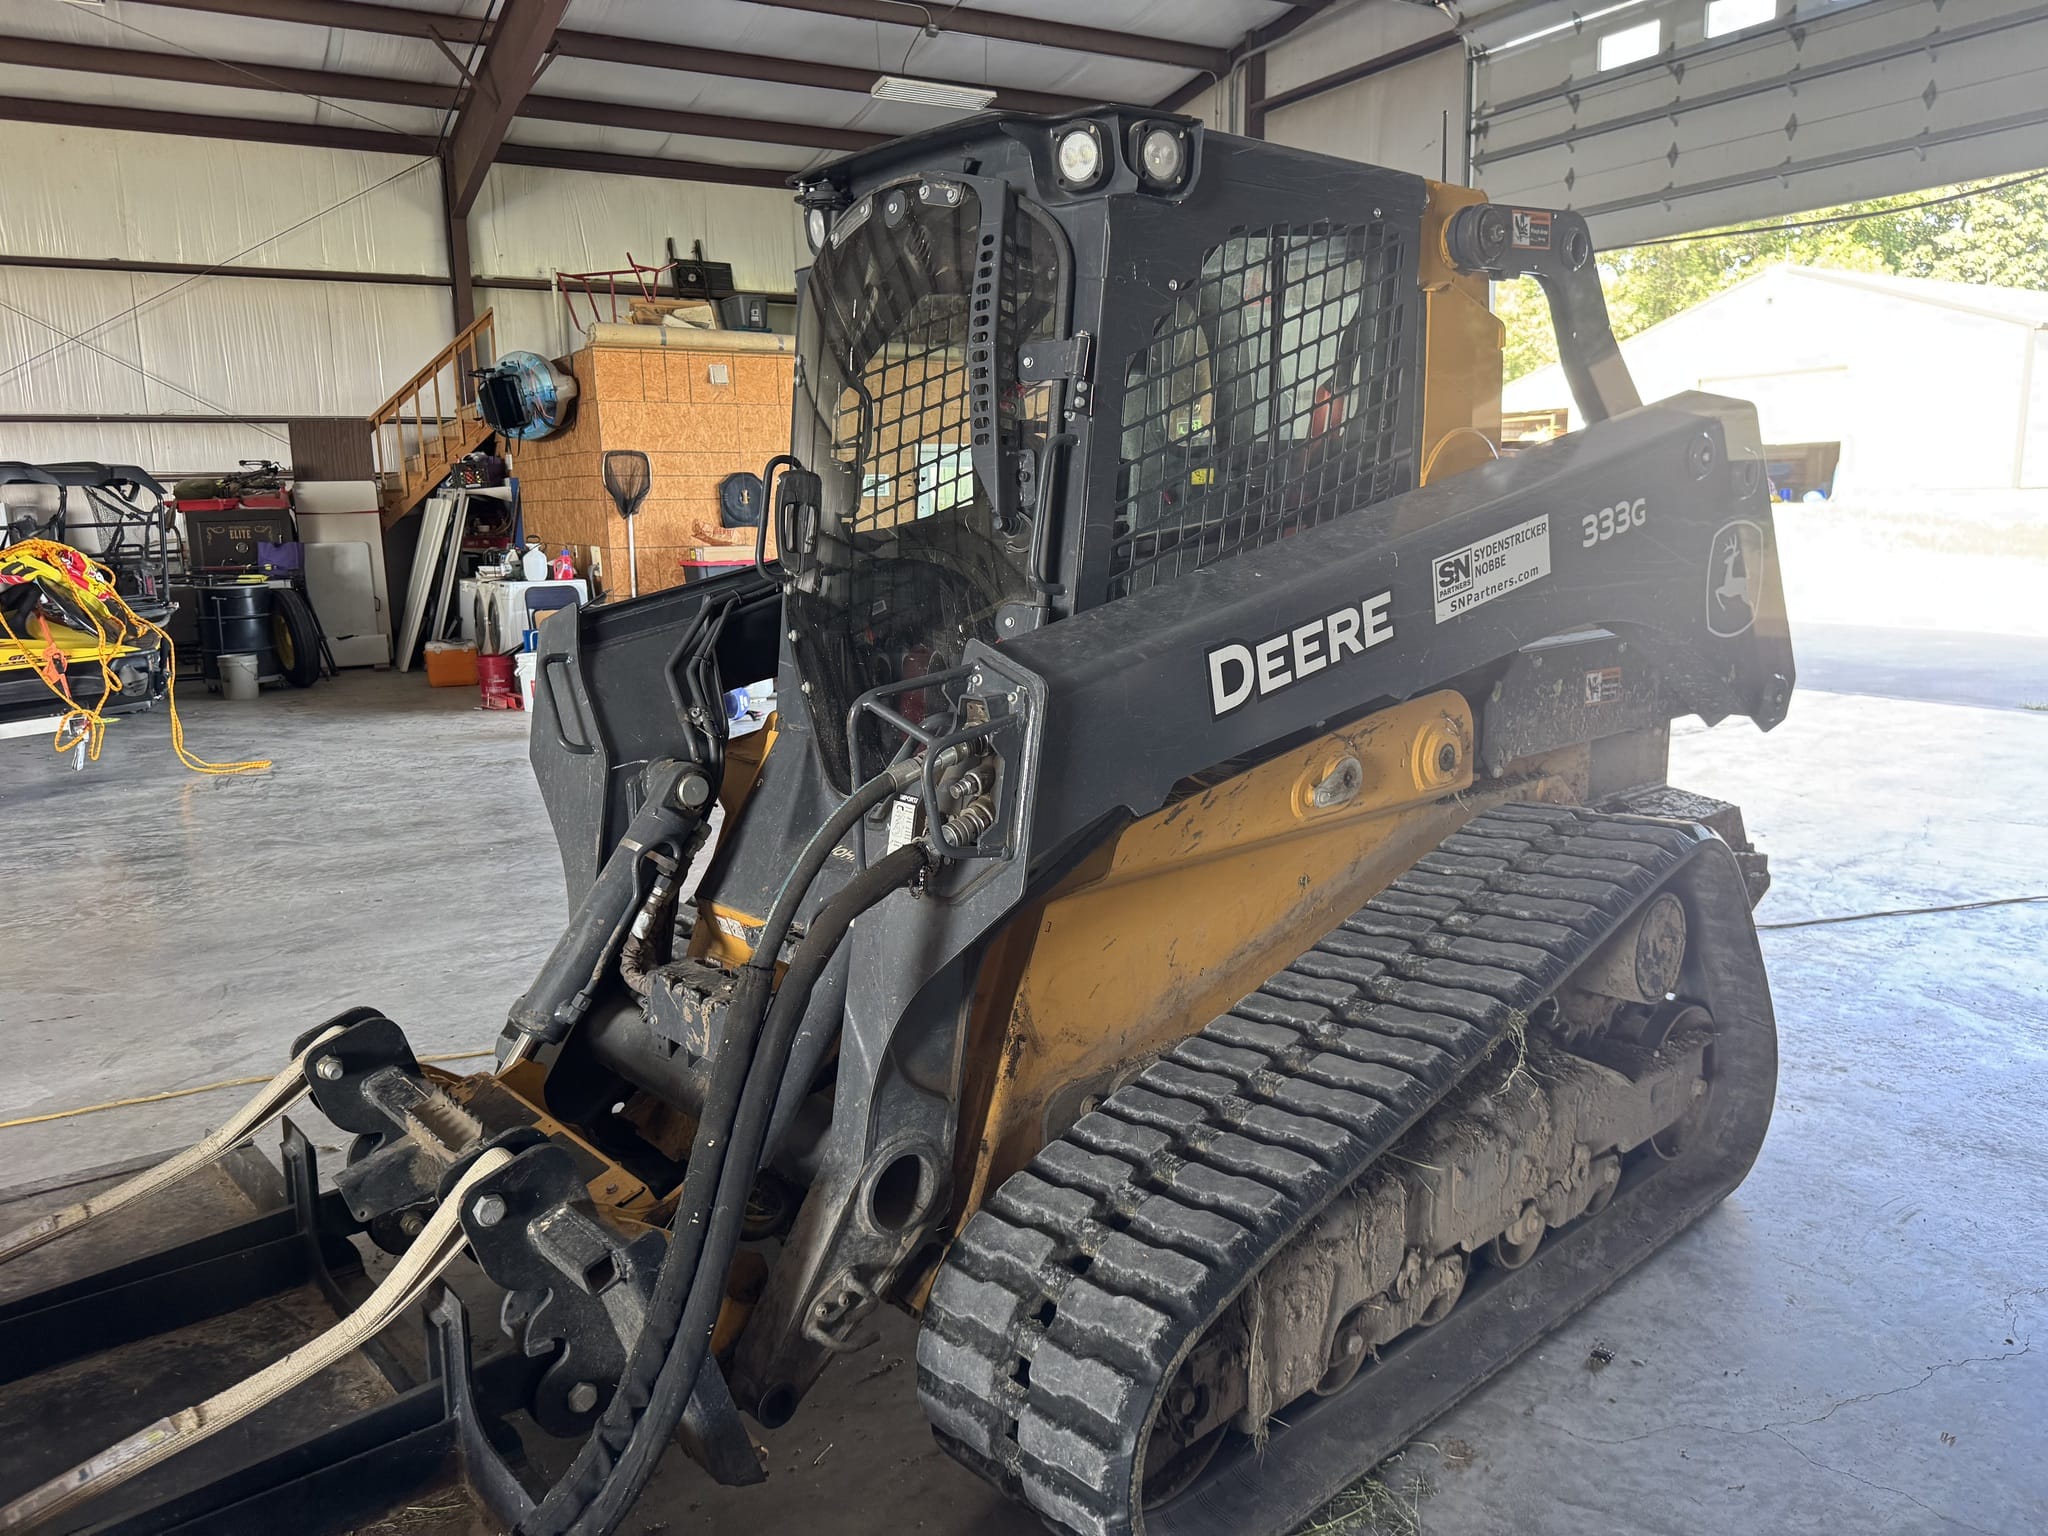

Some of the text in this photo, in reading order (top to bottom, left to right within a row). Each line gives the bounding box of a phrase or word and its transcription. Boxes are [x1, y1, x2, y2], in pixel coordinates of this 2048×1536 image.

[229, 529, 252, 540] ELITE
[1582, 497, 1646, 548] 333G
[1473, 522, 1548, 562] SYDENSTRICKER
[1438, 554, 1471, 589] SN
[1474, 554, 1507, 578] NOBBE
[1439, 579, 1472, 598] PARTNERS
[1450, 565, 1540, 613] SNPartners.com
[1208, 591, 1395, 715] DEERE
